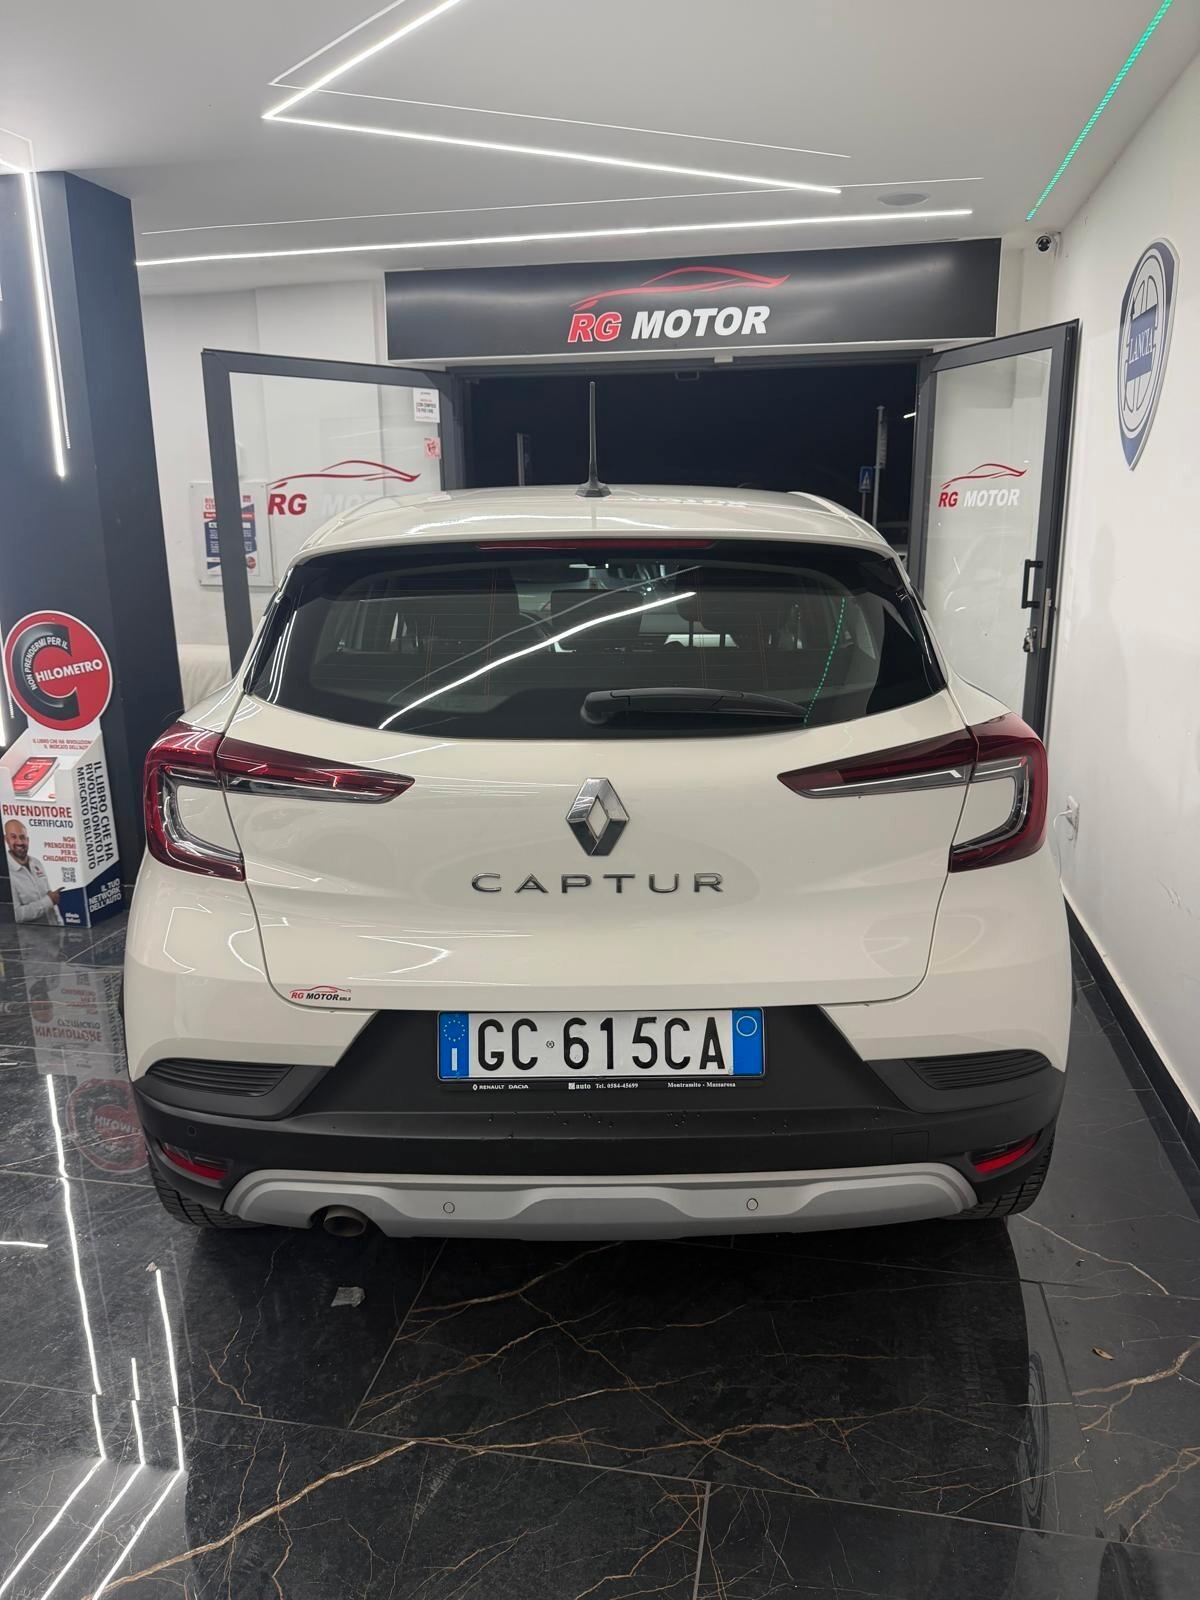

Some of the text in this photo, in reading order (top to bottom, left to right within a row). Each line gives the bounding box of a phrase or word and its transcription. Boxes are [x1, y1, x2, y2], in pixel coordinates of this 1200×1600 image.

[567, 305, 771, 343] RG MOTOR
[267, 493, 308, 516] RG
[937, 488, 1020, 508] RG MOTOR
[24, 636, 69, 691] NON PRENDERMI PER IL
[2, 804, 73, 818] RIVENDITORE
[77, 767, 97, 870] MERCATO DELL'AUTO
[85, 763, 105, 866] RIVOLUZIONATO IL
[93, 761, 114, 862] IL LIBRO CHE HA
[28, 818, 74, 829] CERTIFICATO
[44, 841, 77, 849] PRENDERMI
[42, 855, 79, 863] CHILOMETRO
[107, 878, 121, 889] TUO
[471, 872, 724, 894] CAPTUR
[88, 885, 121, 906] NETWORK
[89, 892, 122, 913] DELL'AUTO
[305, 992, 340, 1001] MOTOR
[477, 1016, 726, 1072] GC 615CA
